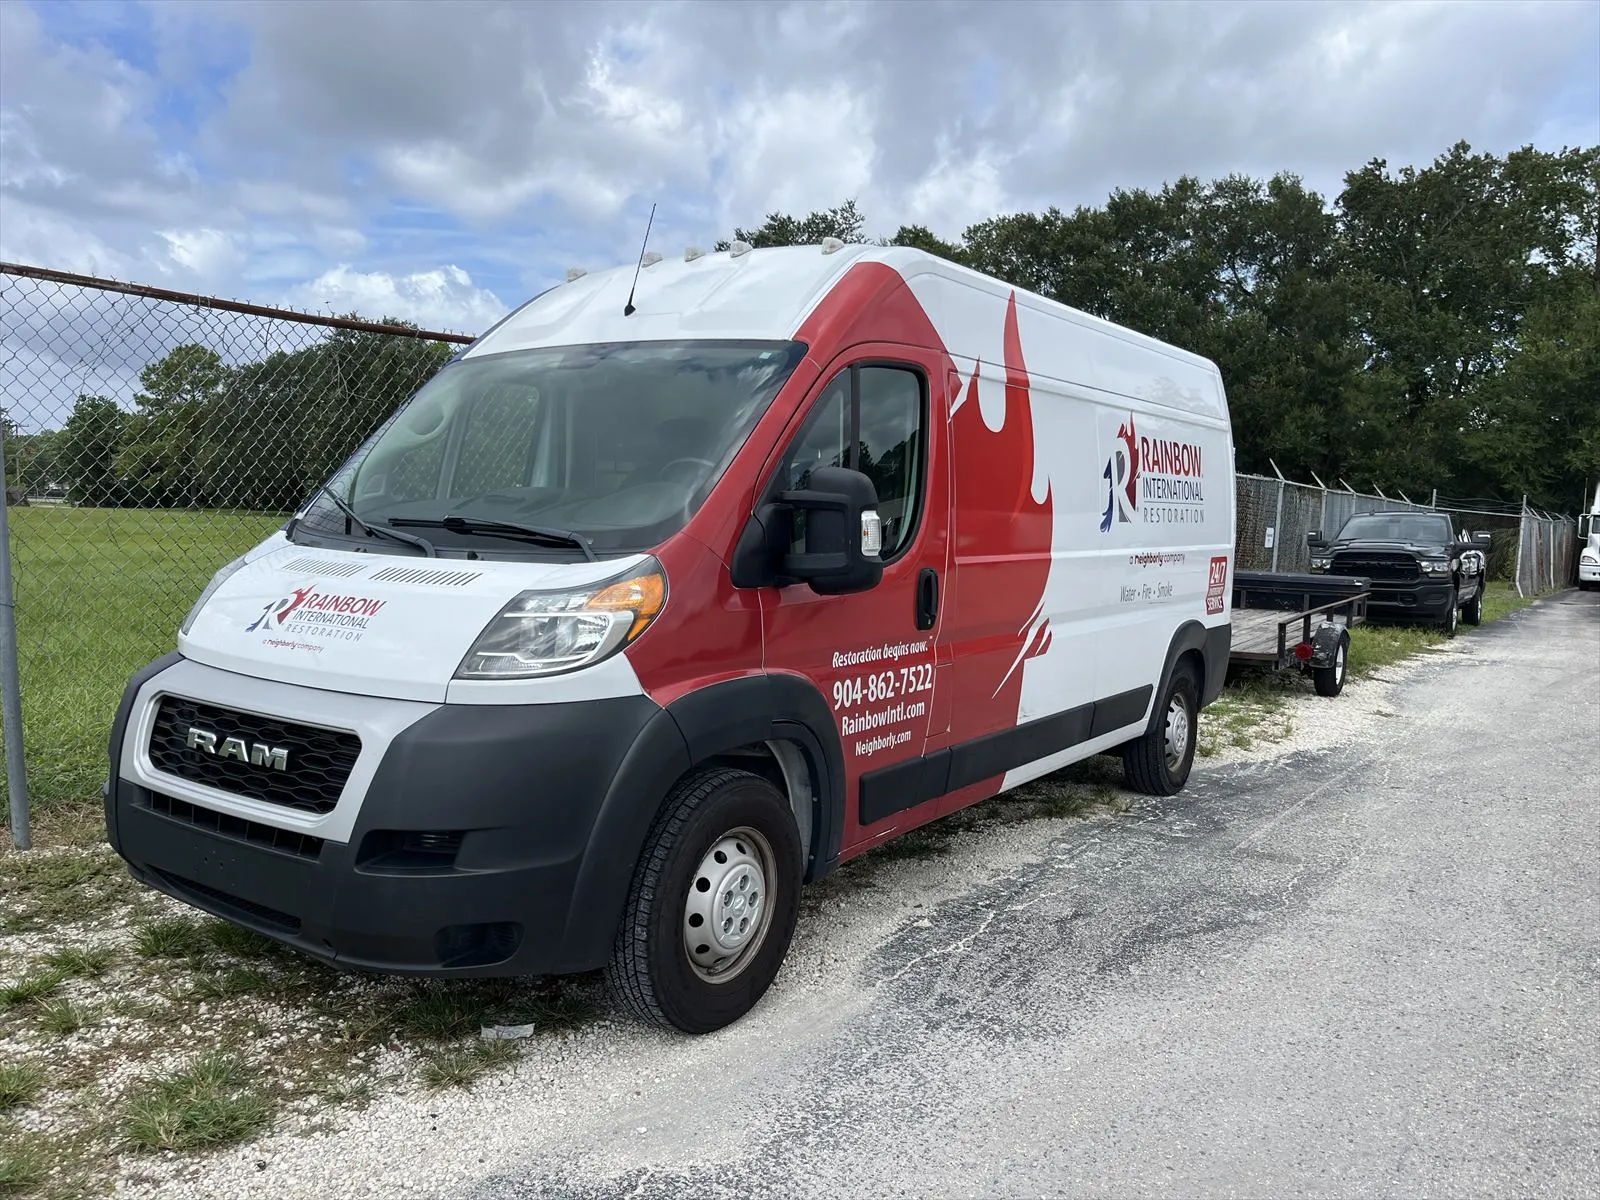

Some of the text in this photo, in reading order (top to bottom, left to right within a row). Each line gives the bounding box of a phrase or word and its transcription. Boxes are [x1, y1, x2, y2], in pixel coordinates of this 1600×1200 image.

[1141, 436, 1201, 478] RAINBOW
[1143, 477, 1203, 501] INTERNATIONAL
[1143, 507, 1204, 523] RESTORATION
[1129, 552, 1185, 568] a neighborly company
[1210, 562, 1226, 584] 24/7
[1120, 581, 1173, 602] Water Fire Smoke
[302, 593, 388, 617] RAINBOW
[292, 610, 370, 629] INTERNATIONAL
[284, 624, 363, 642] RESTORATION
[268, 639, 297, 650] neighborly
[297, 642, 325, 654] company
[832, 640, 928, 668] Restoration begins now.
[833, 664, 932, 710] 904-862-7522
[842, 702, 925, 736] RainbowIntl.com
[186, 727, 289, 771] RAM
[855, 731, 911, 756] Neighborly.com
